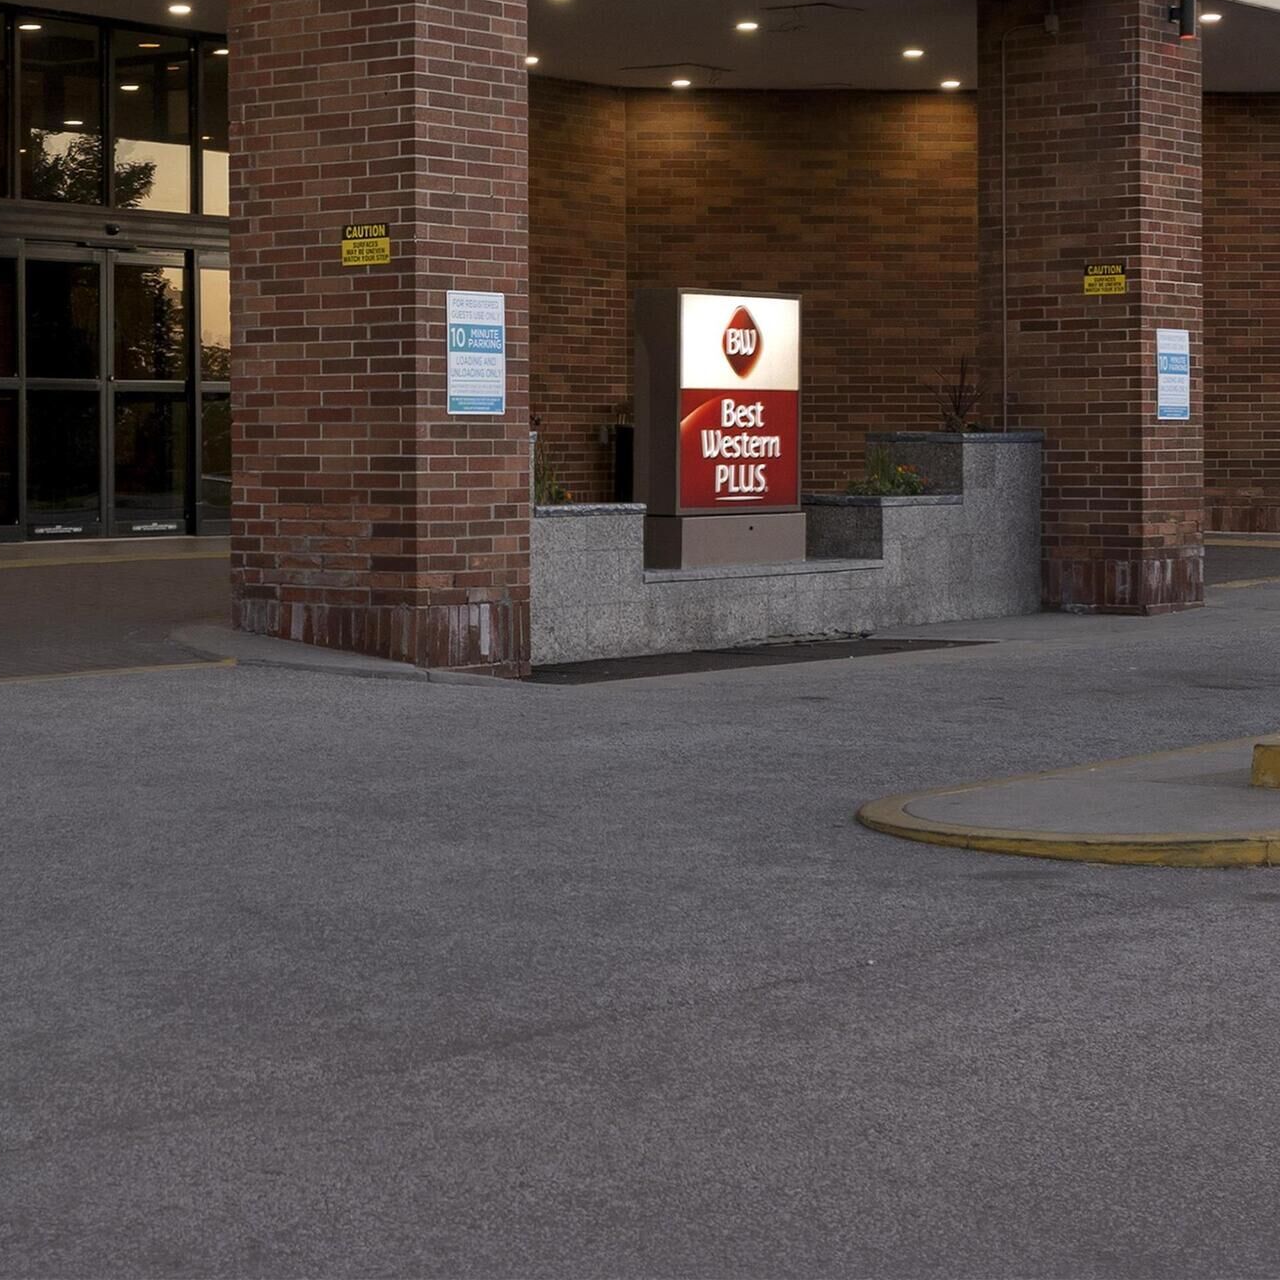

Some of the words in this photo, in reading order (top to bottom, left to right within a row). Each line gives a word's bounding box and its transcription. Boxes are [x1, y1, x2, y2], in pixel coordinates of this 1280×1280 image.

[346, 225, 386, 238] CAUTION
[1088, 264, 1122, 274] CAUTION
[450, 327, 466, 348] 10
[470, 328, 499, 340] MINUTE
[726, 328, 756, 356] BW
[467, 338, 502, 350] PARKING
[1159, 355, 1169, 371] 10
[721, 399, 765, 428] Best
[701, 430, 781, 459] Western
[715, 464, 767, 493] PLUS
